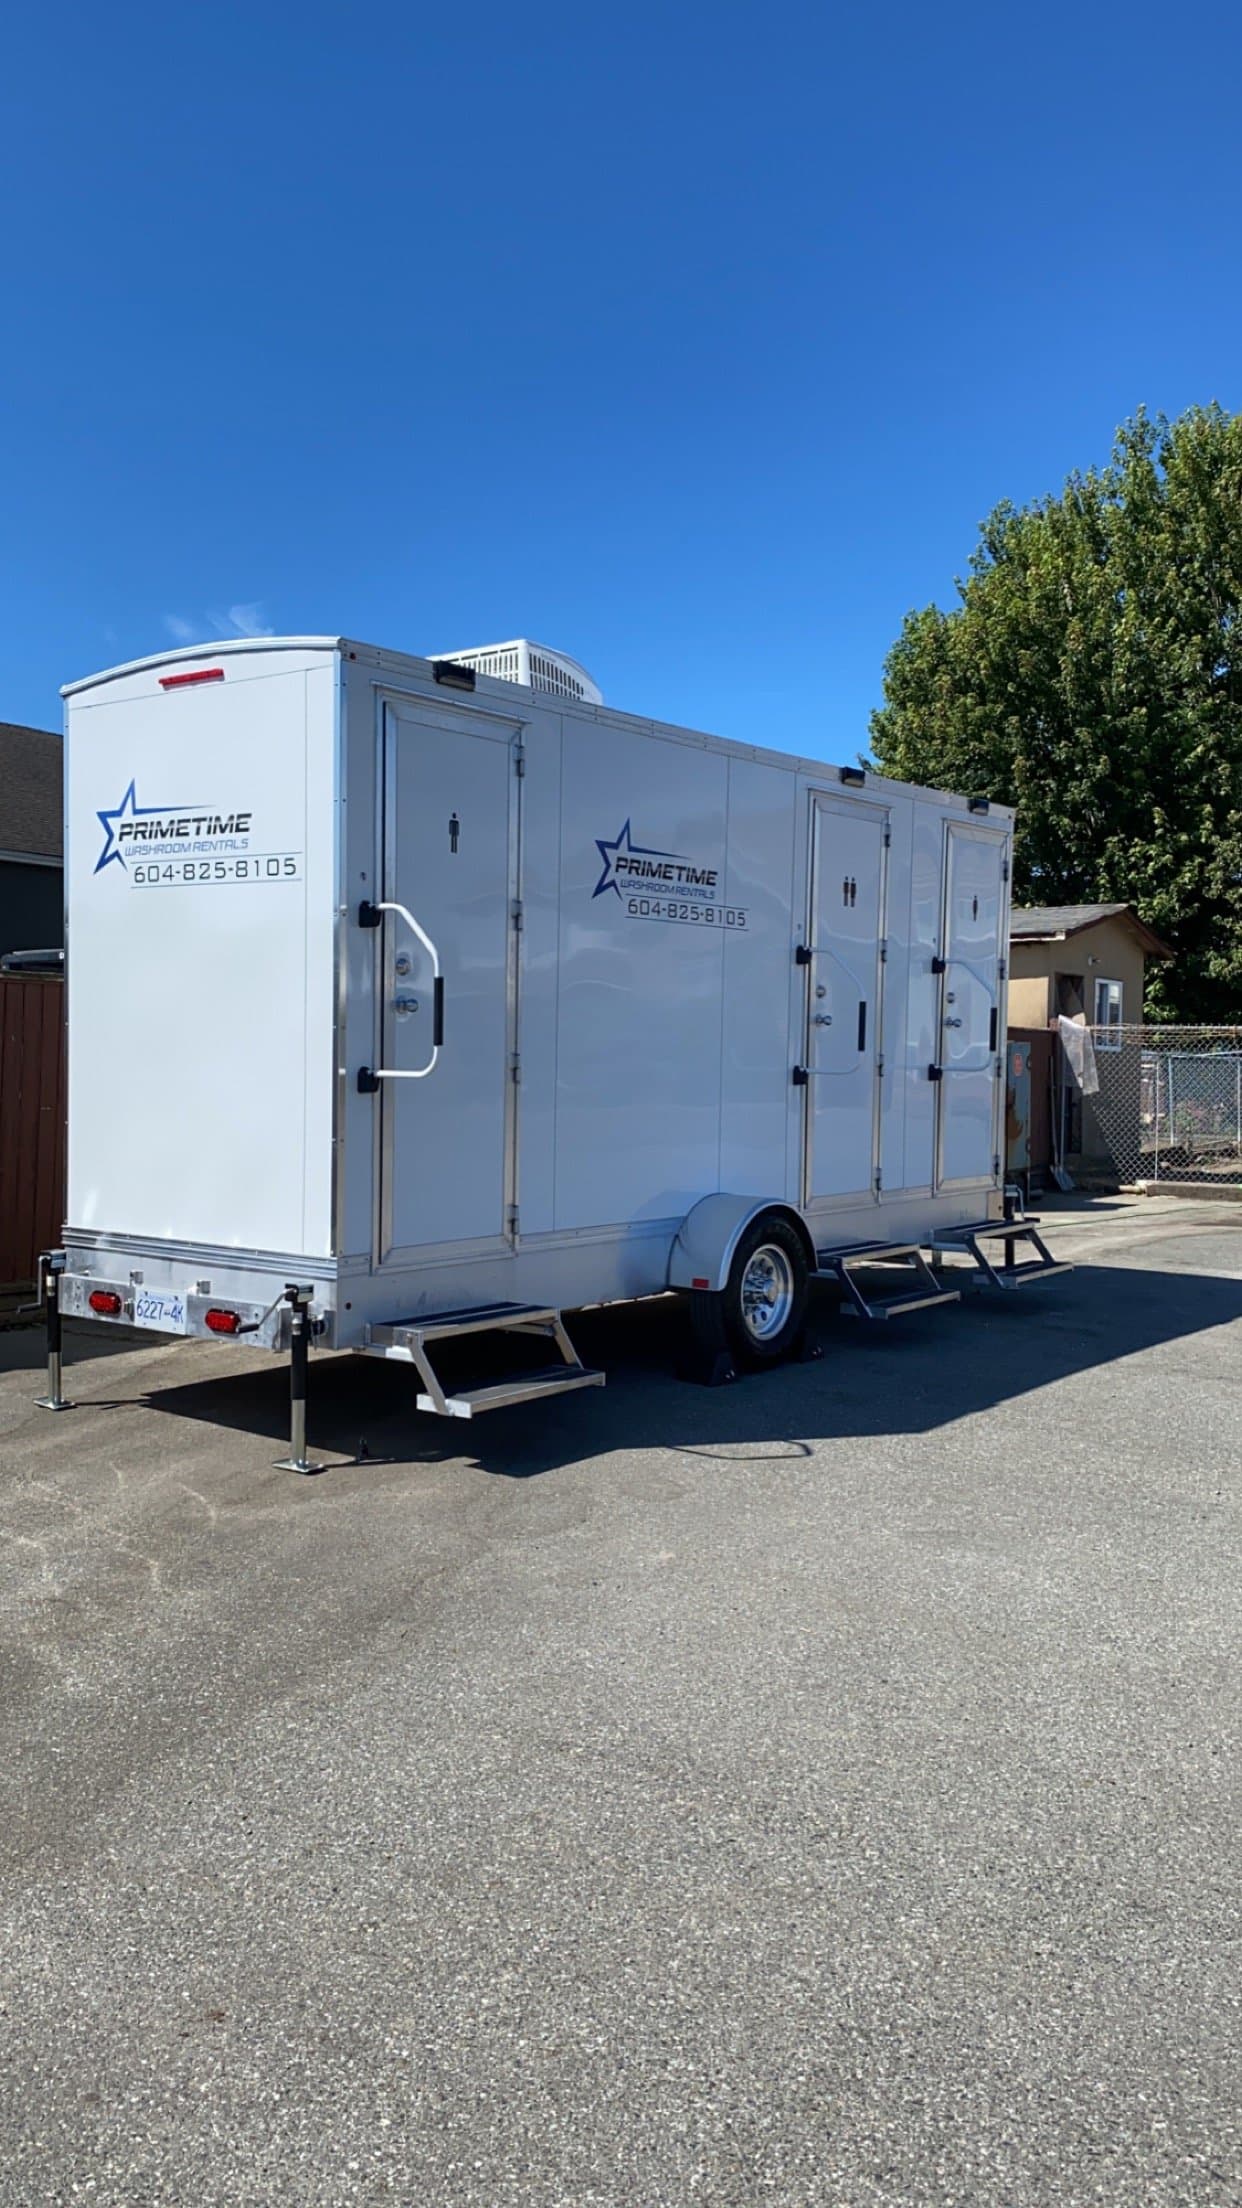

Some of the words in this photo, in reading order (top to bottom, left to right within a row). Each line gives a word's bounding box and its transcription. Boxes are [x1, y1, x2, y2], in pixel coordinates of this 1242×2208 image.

[118, 813, 252, 842] PRIMETIME
[125, 842, 191, 857] WASHROOM
[192, 838, 249, 853] RENTALS
[134, 857, 297, 884] 604-825-8105
[615, 856, 719, 887] PRIMETIME
[620, 879, 674, 894] WASHROOM
[674, 886, 715, 900] RENTALS
[628, 898, 746, 927] 604-825-8105
